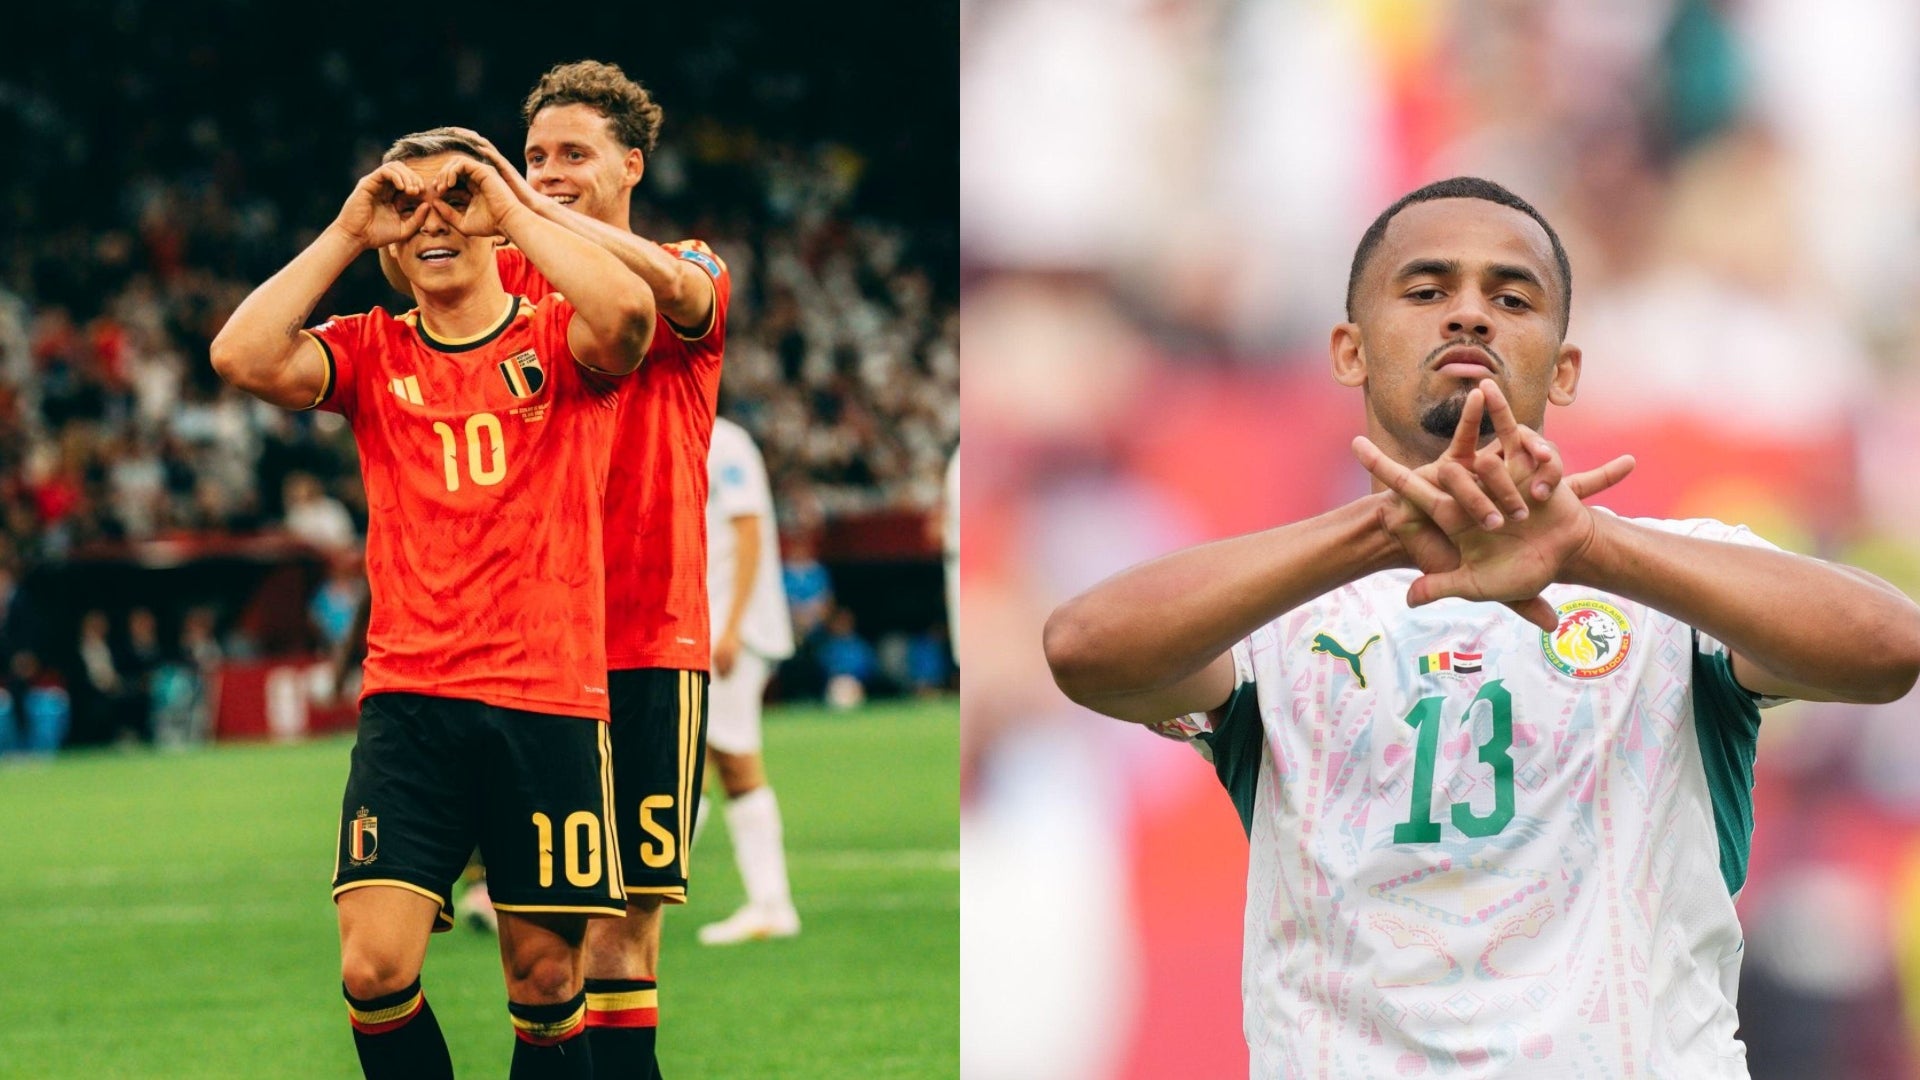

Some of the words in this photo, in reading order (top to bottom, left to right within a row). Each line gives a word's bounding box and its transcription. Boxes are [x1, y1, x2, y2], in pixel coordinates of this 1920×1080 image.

[432, 412, 507, 492] 10
[1580, 651, 1625, 677] FOOTBALL
[1393, 679, 1515, 844] 13
[532, 810, 602, 888] 10
[640, 794, 676, 868] 5
